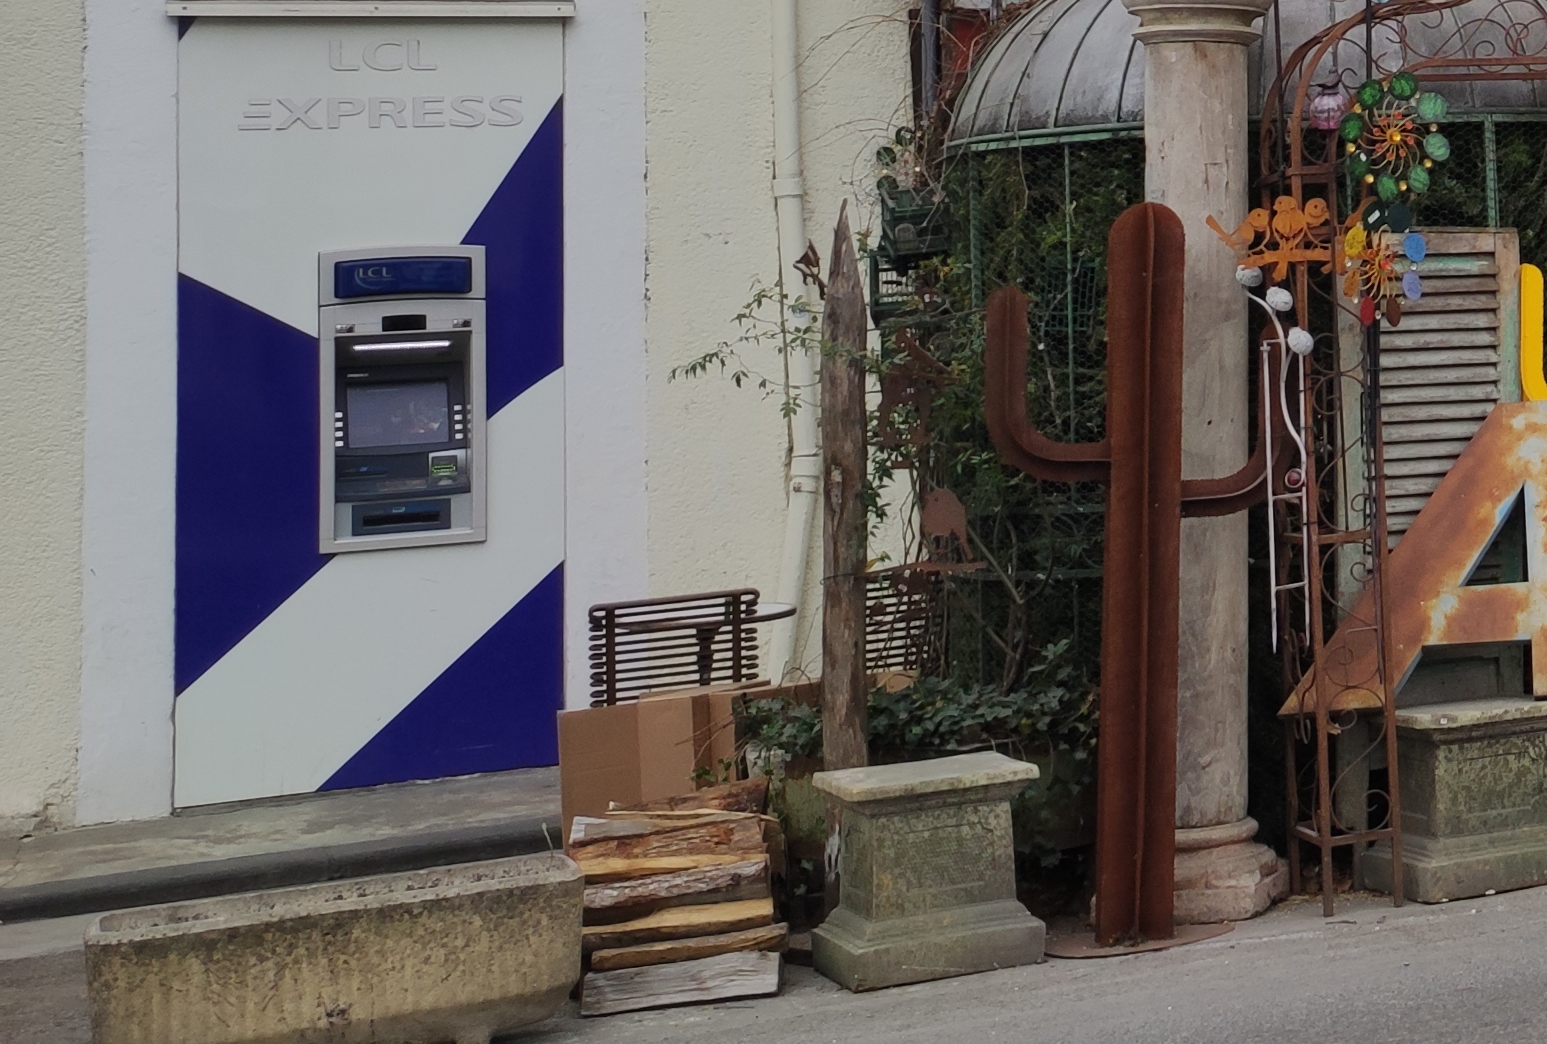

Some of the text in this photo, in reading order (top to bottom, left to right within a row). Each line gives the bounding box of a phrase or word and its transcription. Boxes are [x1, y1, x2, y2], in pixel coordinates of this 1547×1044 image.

[328, 39, 438, 71] LCL
[237, 94, 525, 131] EXPRESS
[357, 266, 392, 279] LCL
